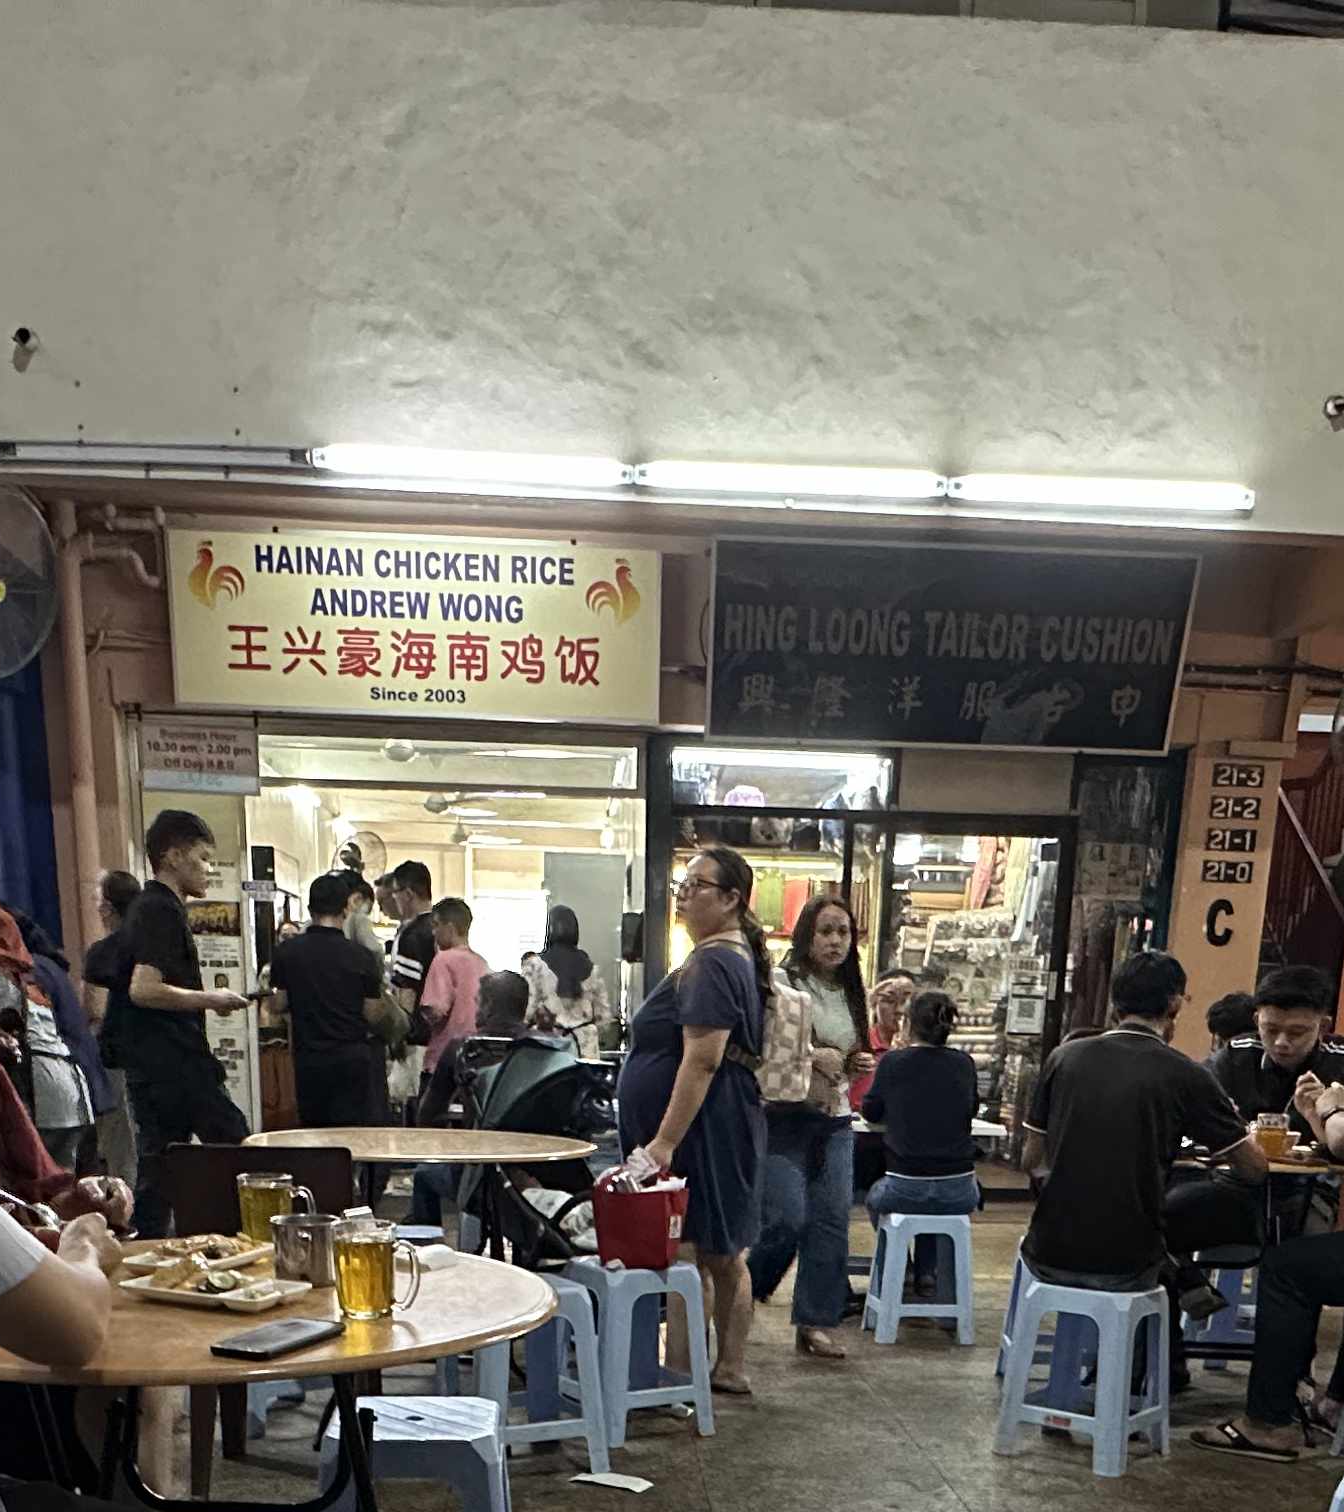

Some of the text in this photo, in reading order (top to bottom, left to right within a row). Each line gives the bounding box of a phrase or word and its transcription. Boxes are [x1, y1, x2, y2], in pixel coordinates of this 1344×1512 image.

[254, 544, 575, 586] HAINAN CHICKEN RICE
[310, 588, 524, 624] ANDREW WONG
[723, 603, 1177, 665] HING LOONG TAILOR CUSHION
[227, 624, 601, 687] 王兴豪海南鸡饭
[370, 686, 467, 703] Since 2003
[1216, 765, 1262, 787] 21-3
[1212, 798, 1257, 819] 21-2
[1209, 831, 1252, 851] 21-1
[1205, 861, 1250, 881] 21-0
[1207, 898, 1235, 947] C
